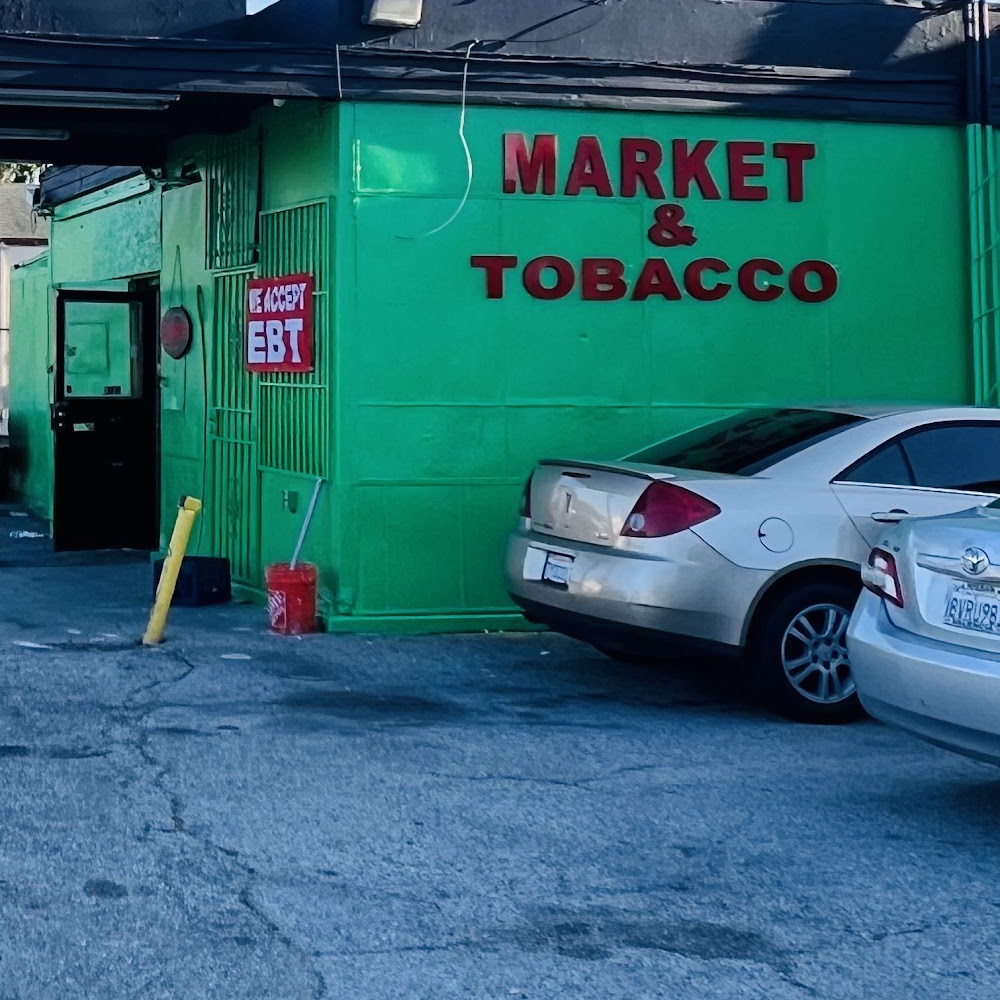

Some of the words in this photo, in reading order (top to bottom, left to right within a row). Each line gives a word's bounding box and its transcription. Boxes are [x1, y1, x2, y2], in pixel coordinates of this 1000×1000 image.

[502, 133, 816, 202] MARKET
[647, 203, 697, 247] &
[264, 283, 307, 313] ACCEPT
[470, 255, 838, 303] TOBACCO
[248, 318, 303, 363] EBT
